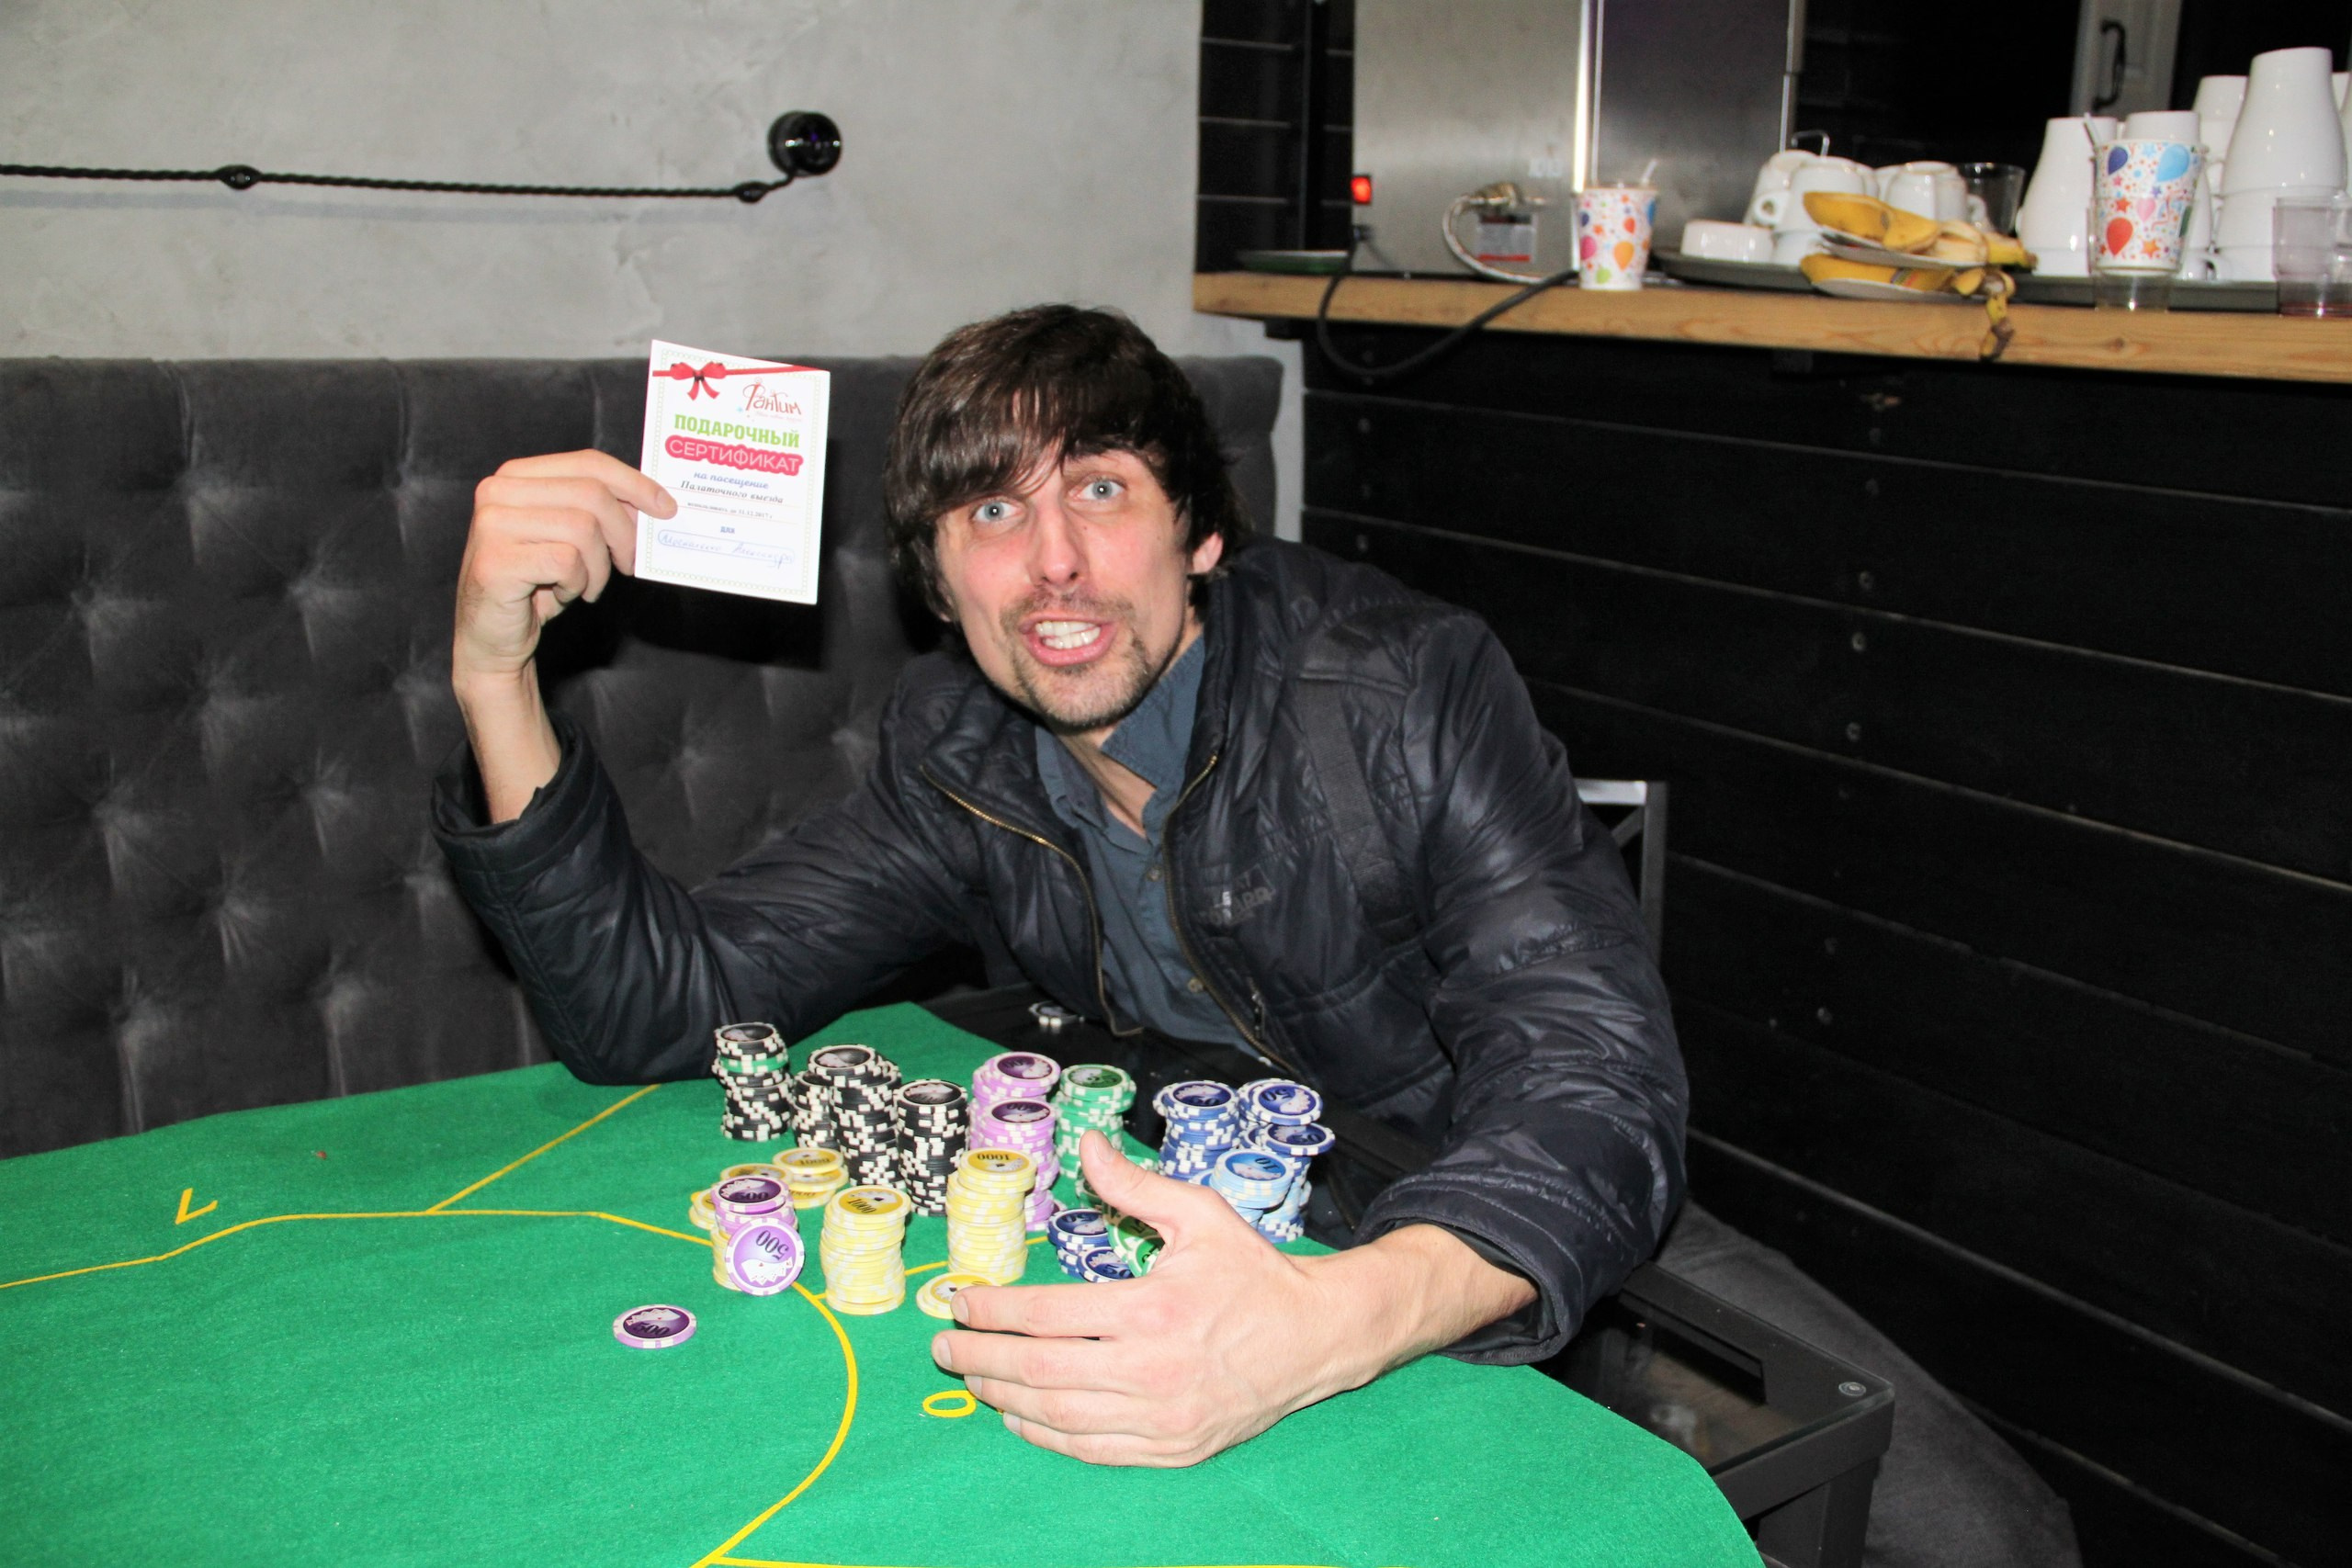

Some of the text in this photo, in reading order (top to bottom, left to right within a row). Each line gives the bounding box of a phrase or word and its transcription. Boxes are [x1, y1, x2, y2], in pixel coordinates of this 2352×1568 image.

[674, 414, 800, 448] ПОДАРОЧНЫЙ
[670, 439, 799, 472] СЕРТИФИКАТ
[694, 471, 770, 490] на посещение
[680, 479, 784, 504] Палаточного выезда
[720, 525, 736, 535] для
[1261, 1089, 1293, 1103] 50
[1288, 1133, 1321, 1145] 50
[798, 1157, 831, 1166] 1000
[977, 1154, 1011, 1162] 1000
[1254, 1156, 1280, 1172] 10
[735, 1191, 769, 1201] 500
[847, 1198, 877, 1214] 1000
[756, 1229, 790, 1261] 500
[633, 1322, 671, 1337] 500
